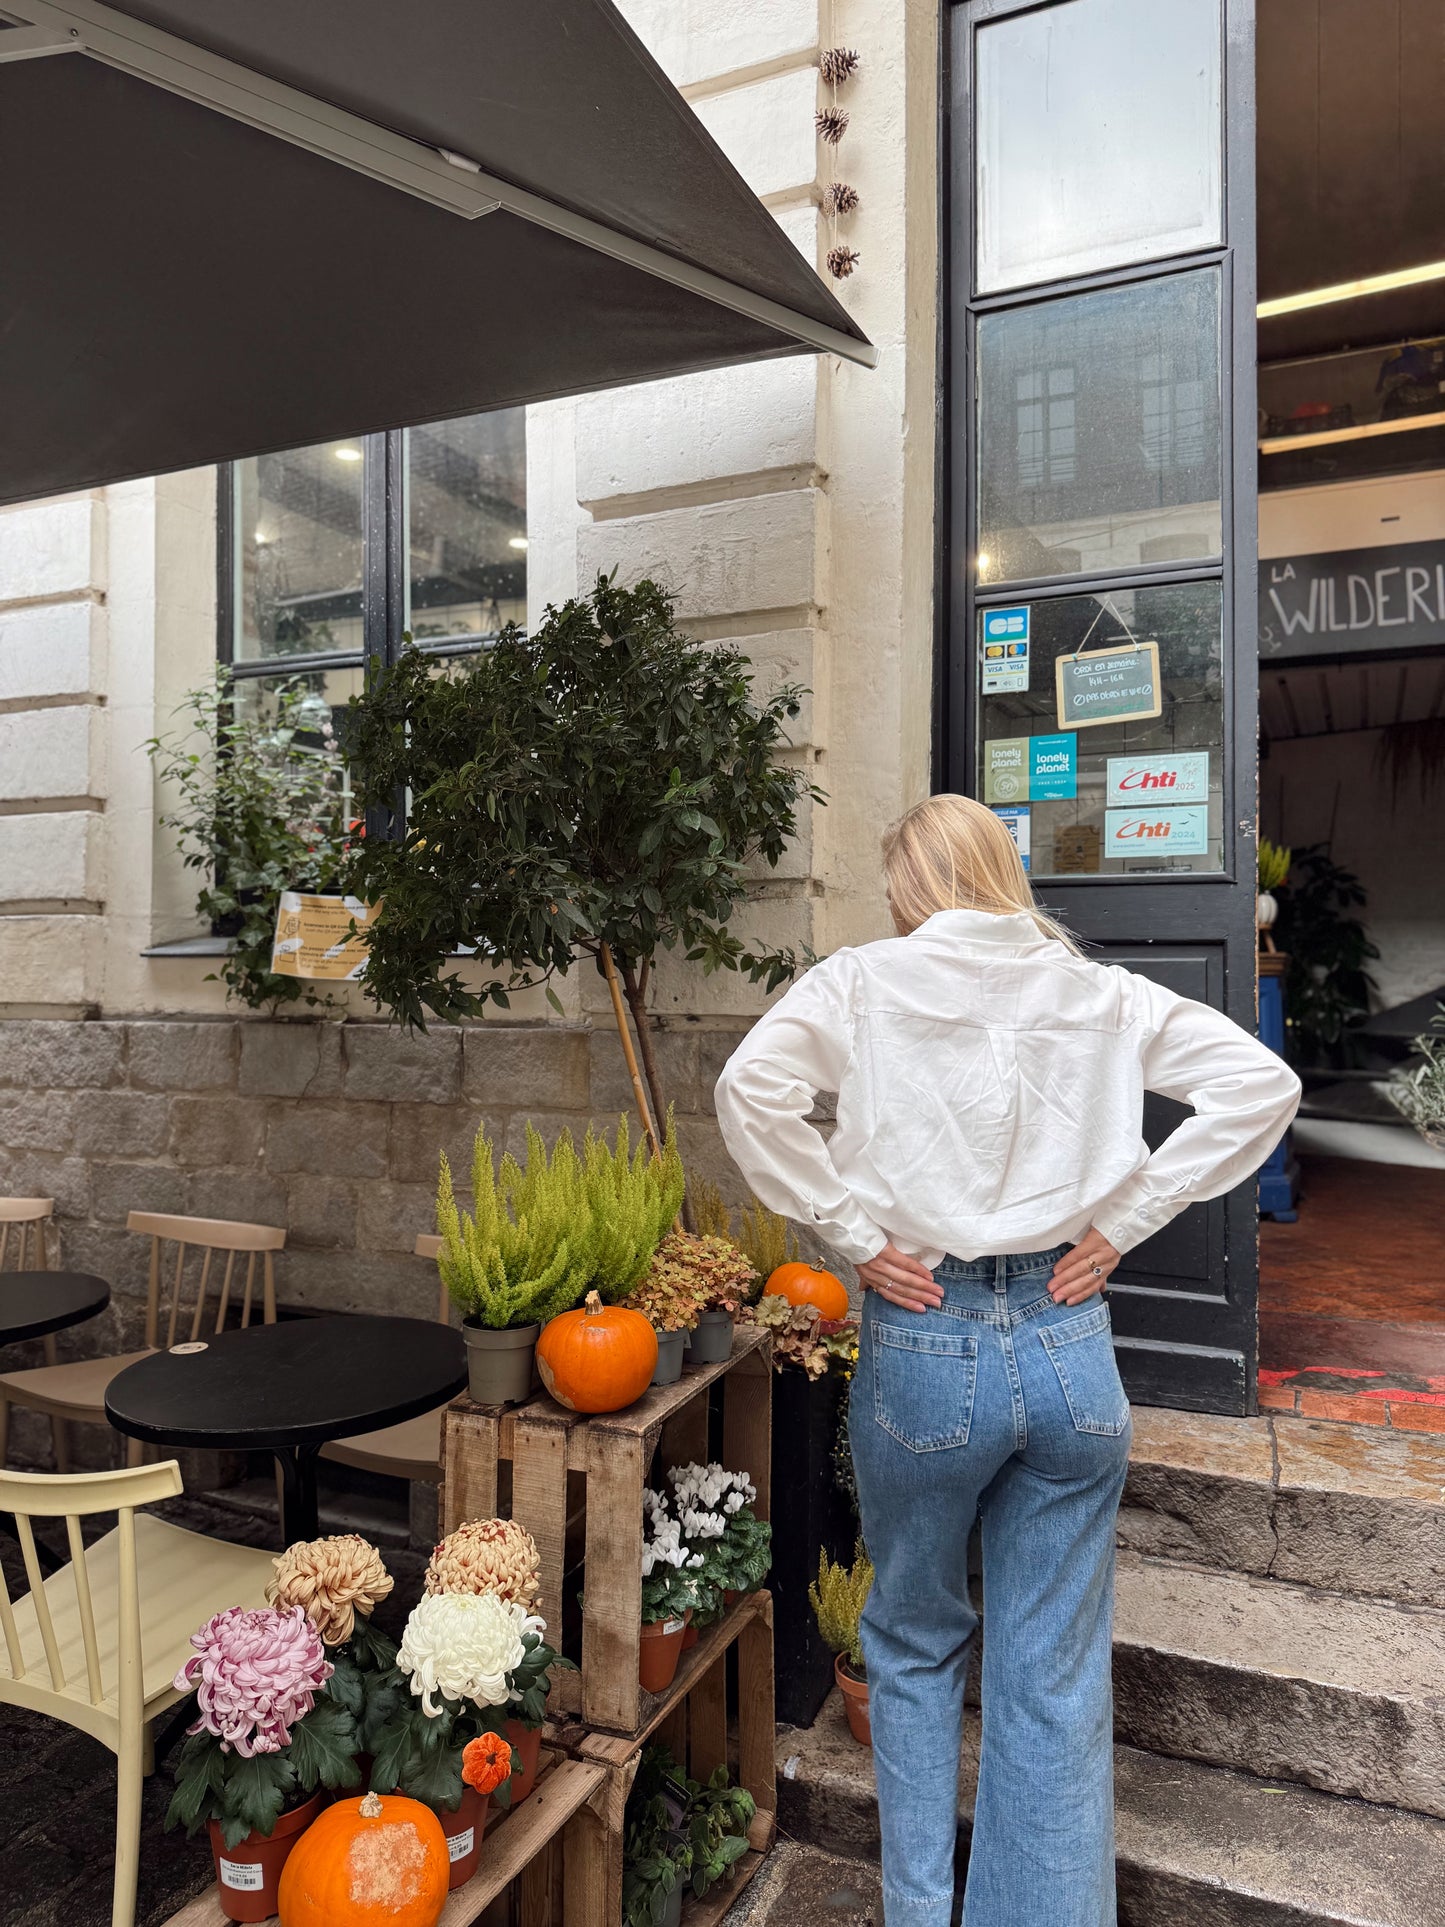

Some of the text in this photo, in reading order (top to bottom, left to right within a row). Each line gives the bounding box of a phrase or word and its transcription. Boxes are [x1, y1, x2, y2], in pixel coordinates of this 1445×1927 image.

[1271, 563, 1296, 583] LA
[1010, 663, 1024, 671] VISA
[992, 748, 1022, 759] lonely
[1036, 752, 1069, 764] lonely
[991, 758, 1022, 769] planet
[1036, 763, 1070, 775] planet
[1118, 767, 1178, 791] Chti
[1175, 782, 1196, 791] 2025
[1115, 818, 1171, 839] Chti
[1171, 831, 1196, 839] 2024
